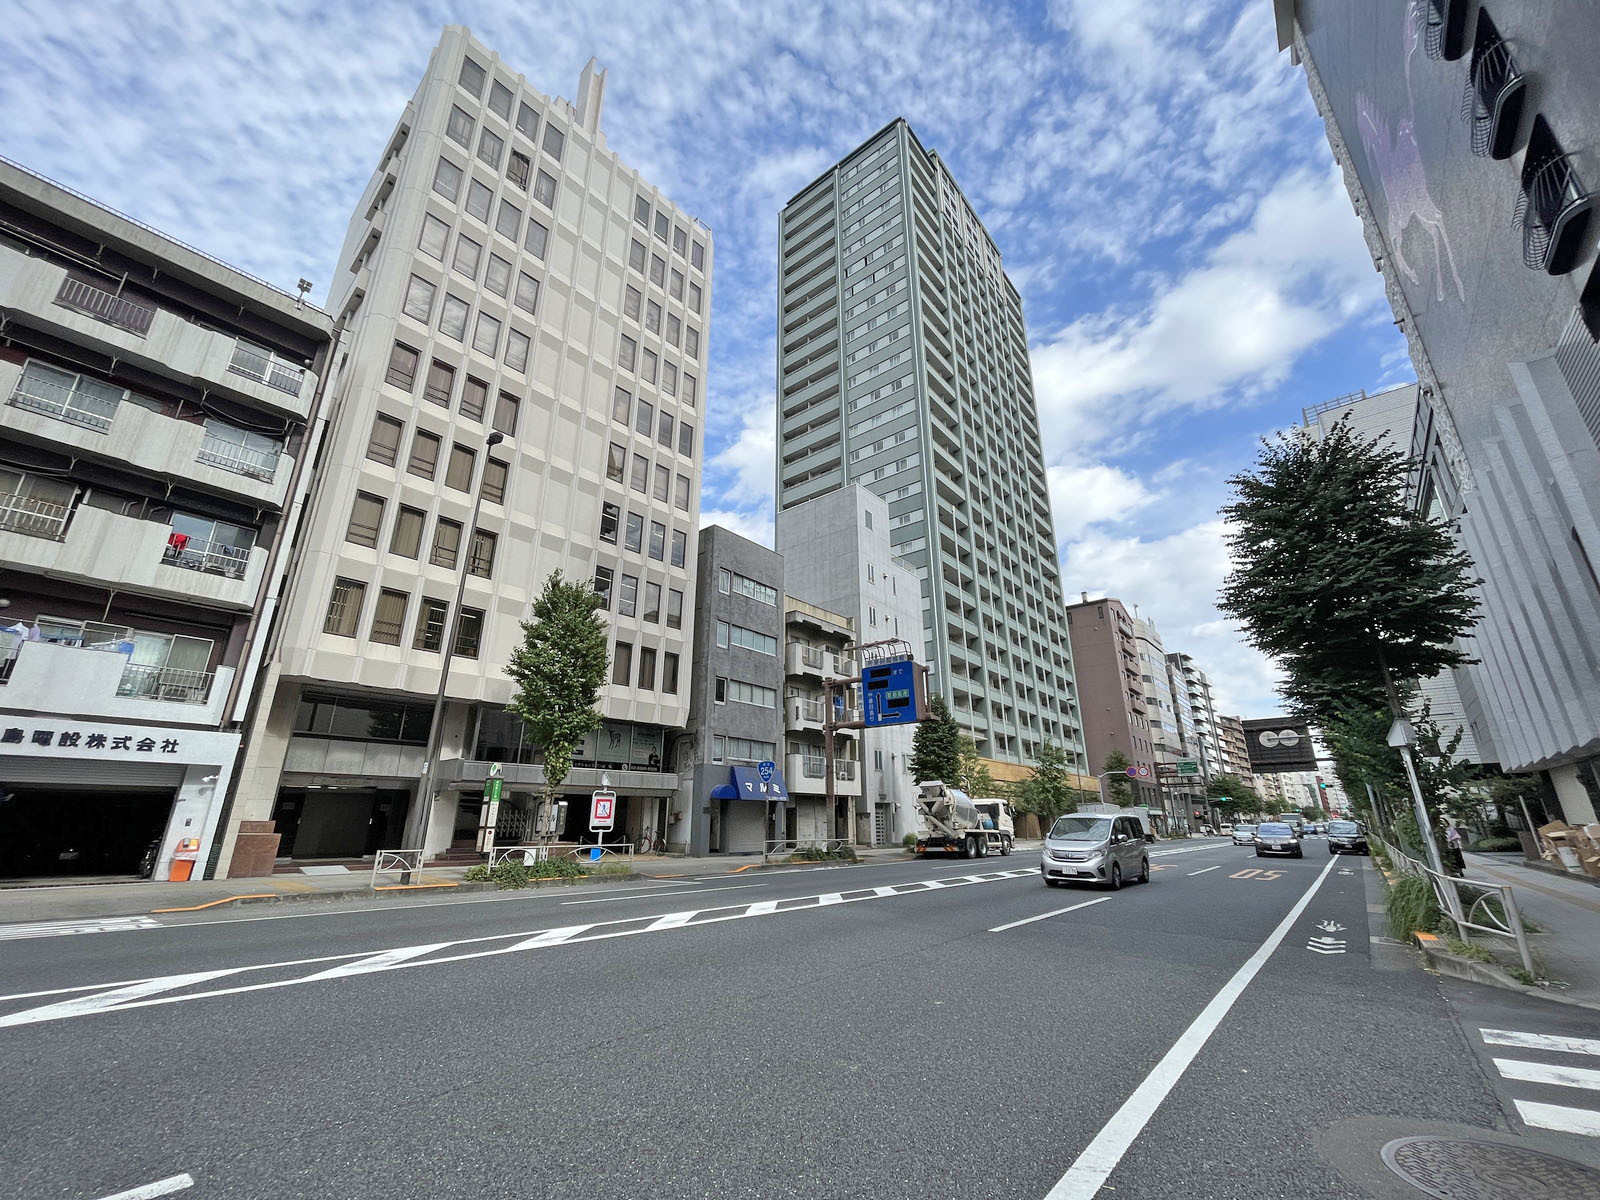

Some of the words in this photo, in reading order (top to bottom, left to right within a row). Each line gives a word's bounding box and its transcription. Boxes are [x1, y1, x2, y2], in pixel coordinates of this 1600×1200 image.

[760, 766, 773, 776] 254
[745, 782, 781, 794] マルミ
